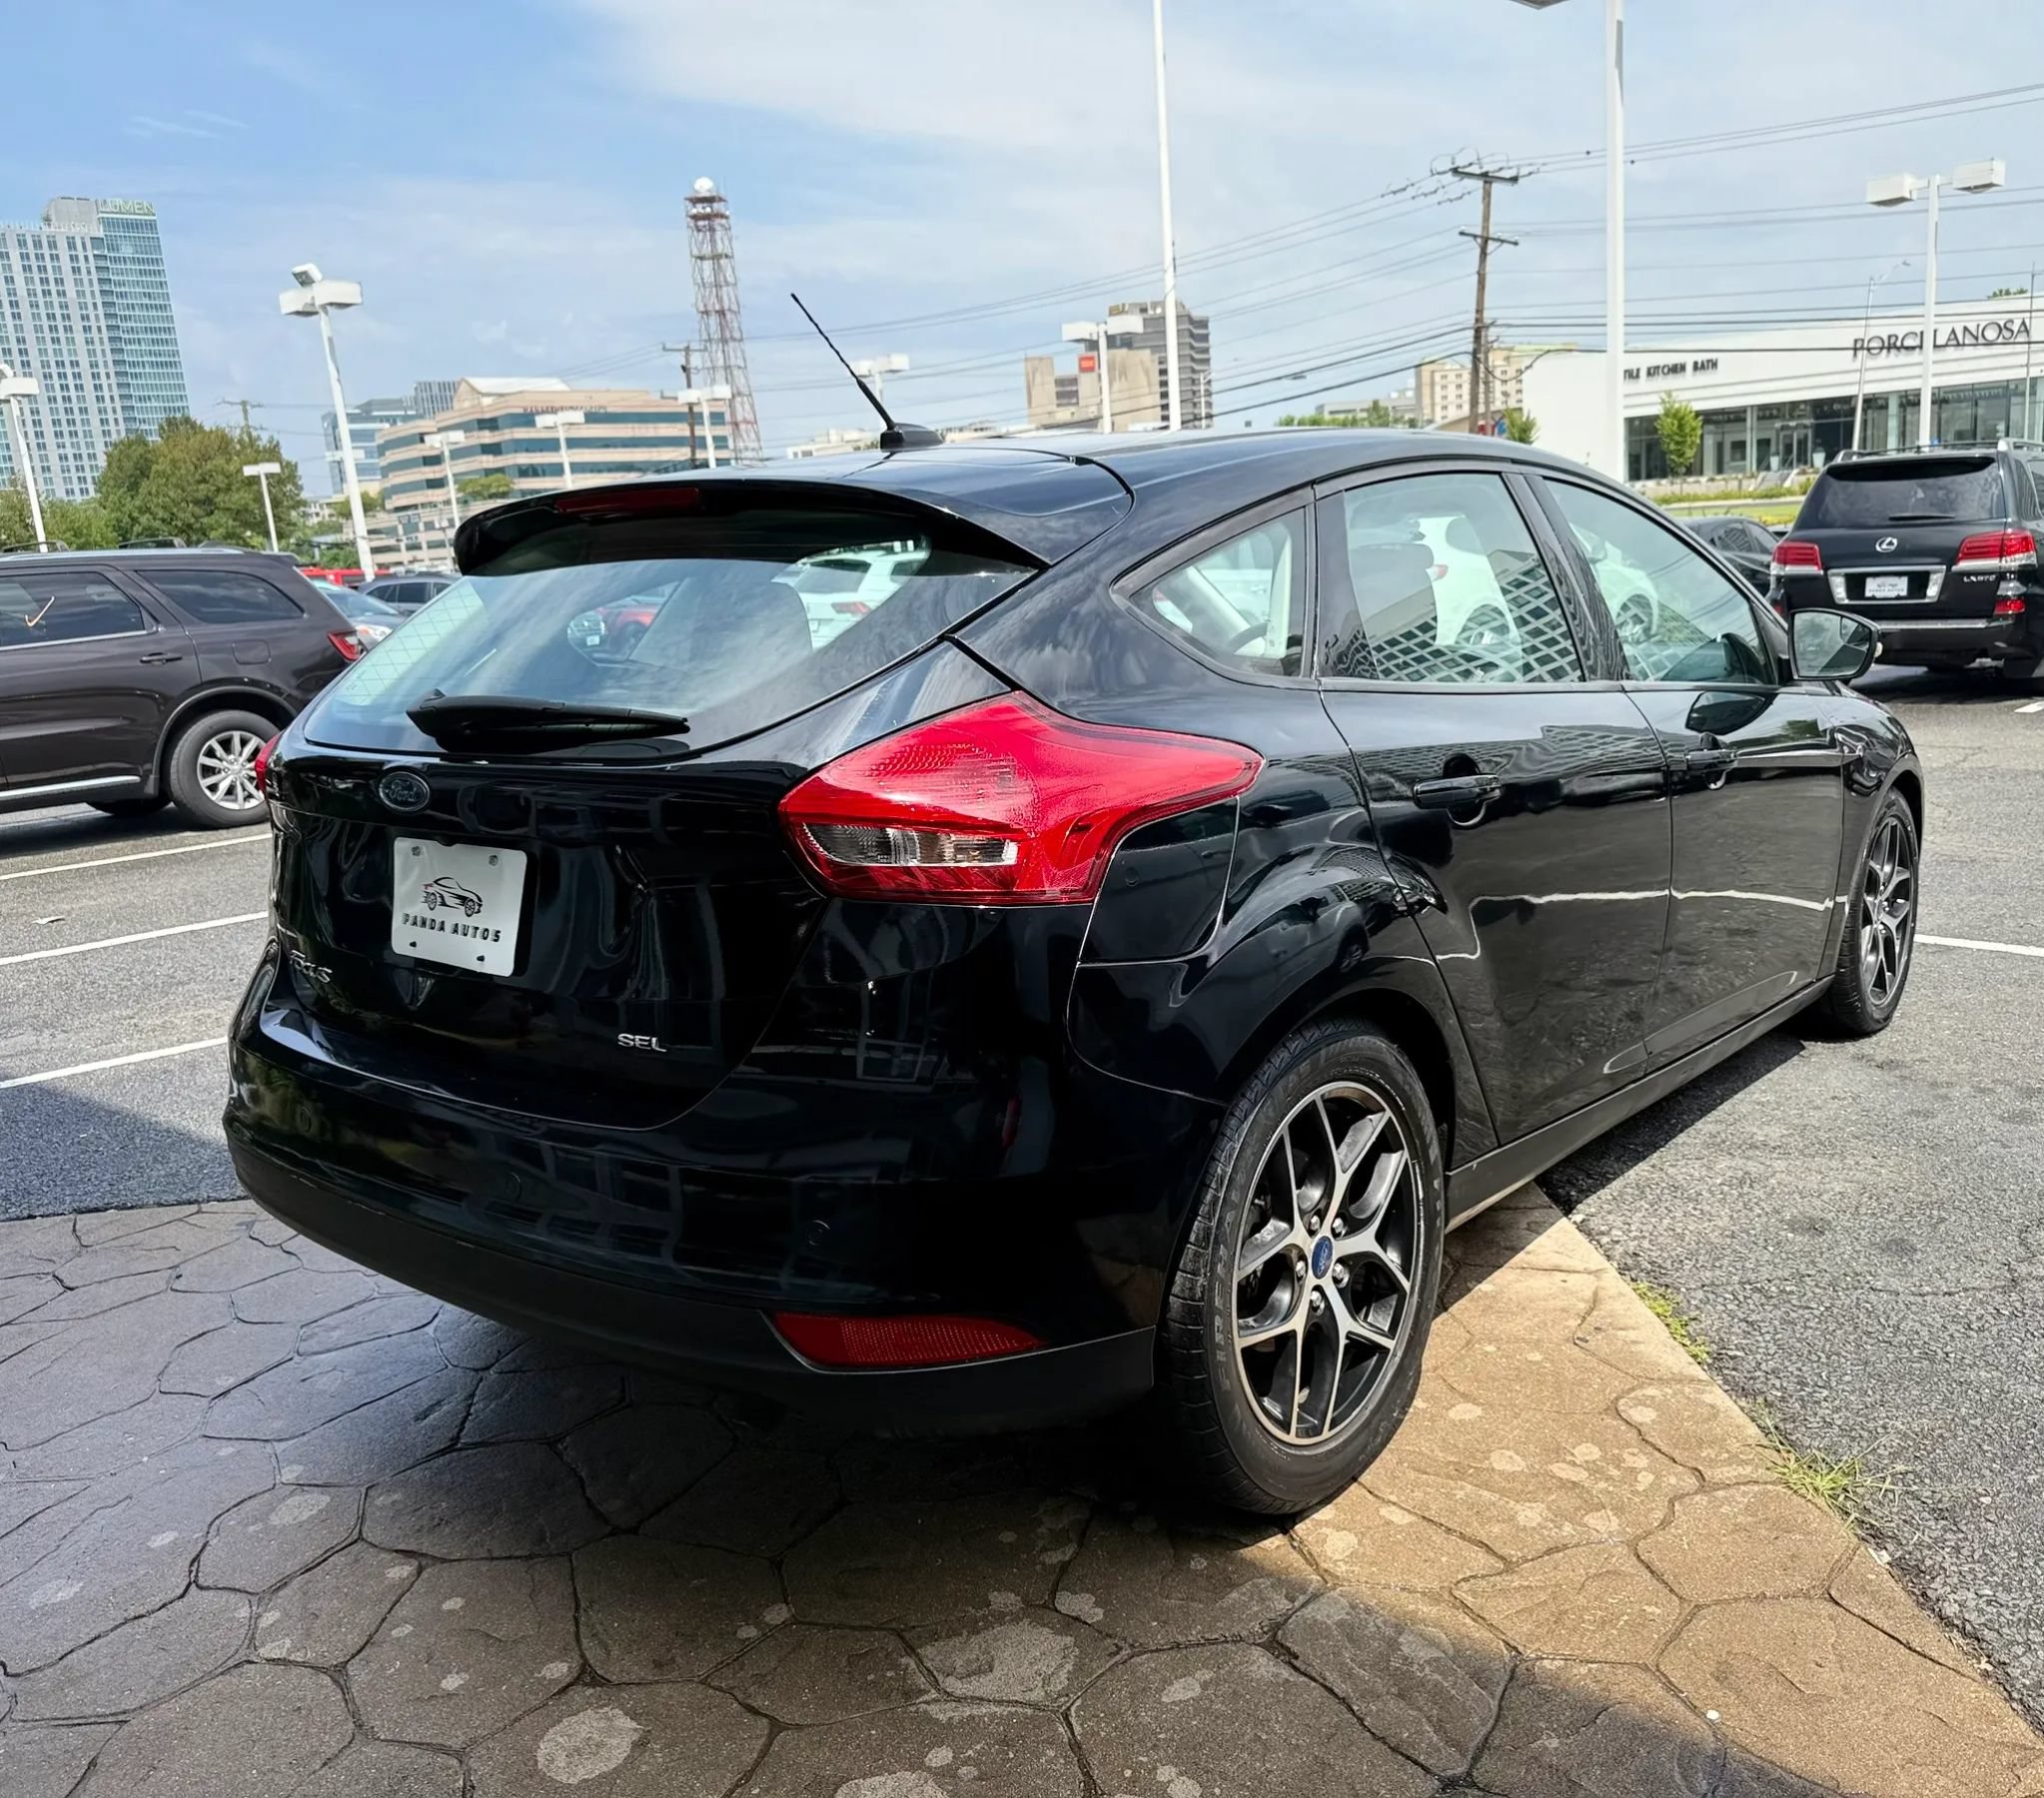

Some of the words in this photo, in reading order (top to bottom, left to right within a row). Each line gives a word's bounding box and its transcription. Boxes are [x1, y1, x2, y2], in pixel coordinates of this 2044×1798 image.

[100, 199, 155, 215] LUMEN
[1646, 363, 1686, 378] KITCHEN
[1693, 359, 1718, 372] BATH
[403, 913, 446, 932] PANDA
[451, 922, 502, 942] AUTOS
[617, 1033, 667, 1052] SEL
